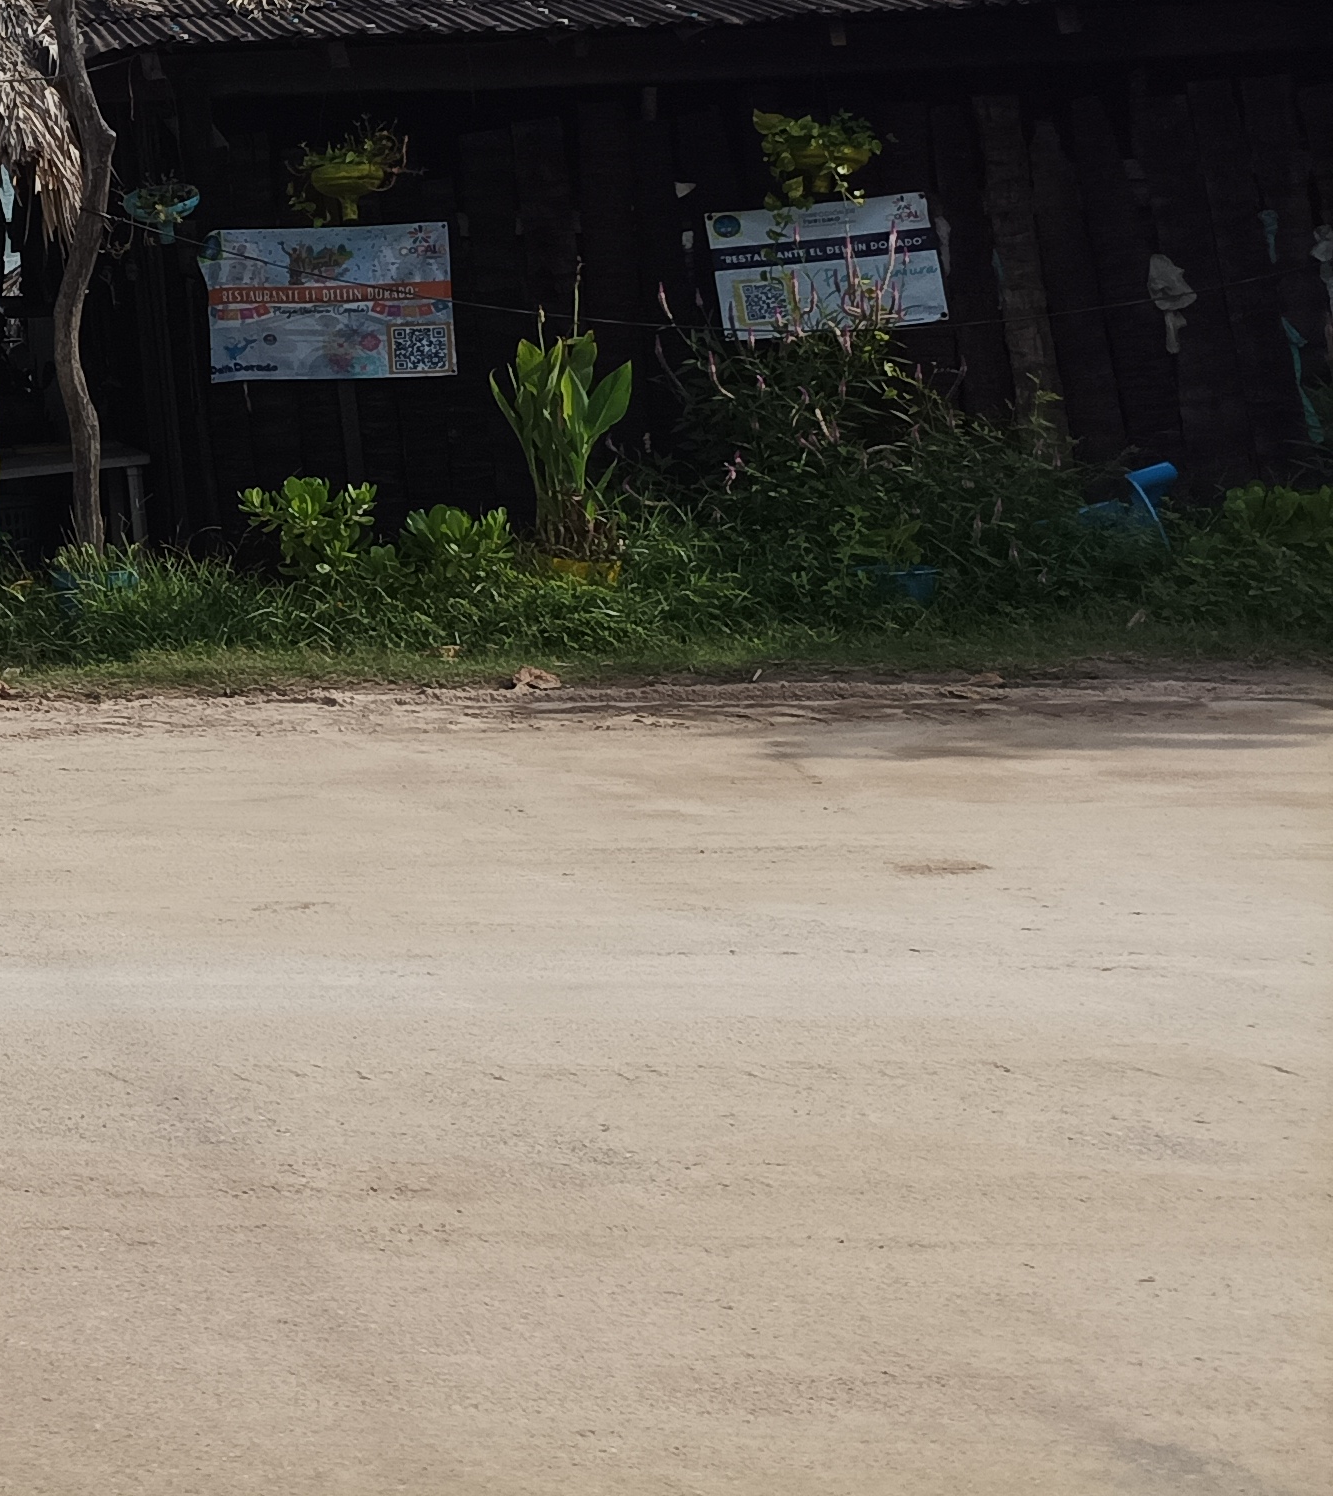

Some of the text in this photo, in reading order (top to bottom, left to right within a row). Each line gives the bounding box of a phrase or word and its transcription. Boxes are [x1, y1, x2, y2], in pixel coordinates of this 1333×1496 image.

[809, 247, 823, 256] EL
[870, 236, 927, 251] DOADO"
[305, 290, 317, 302] EL
